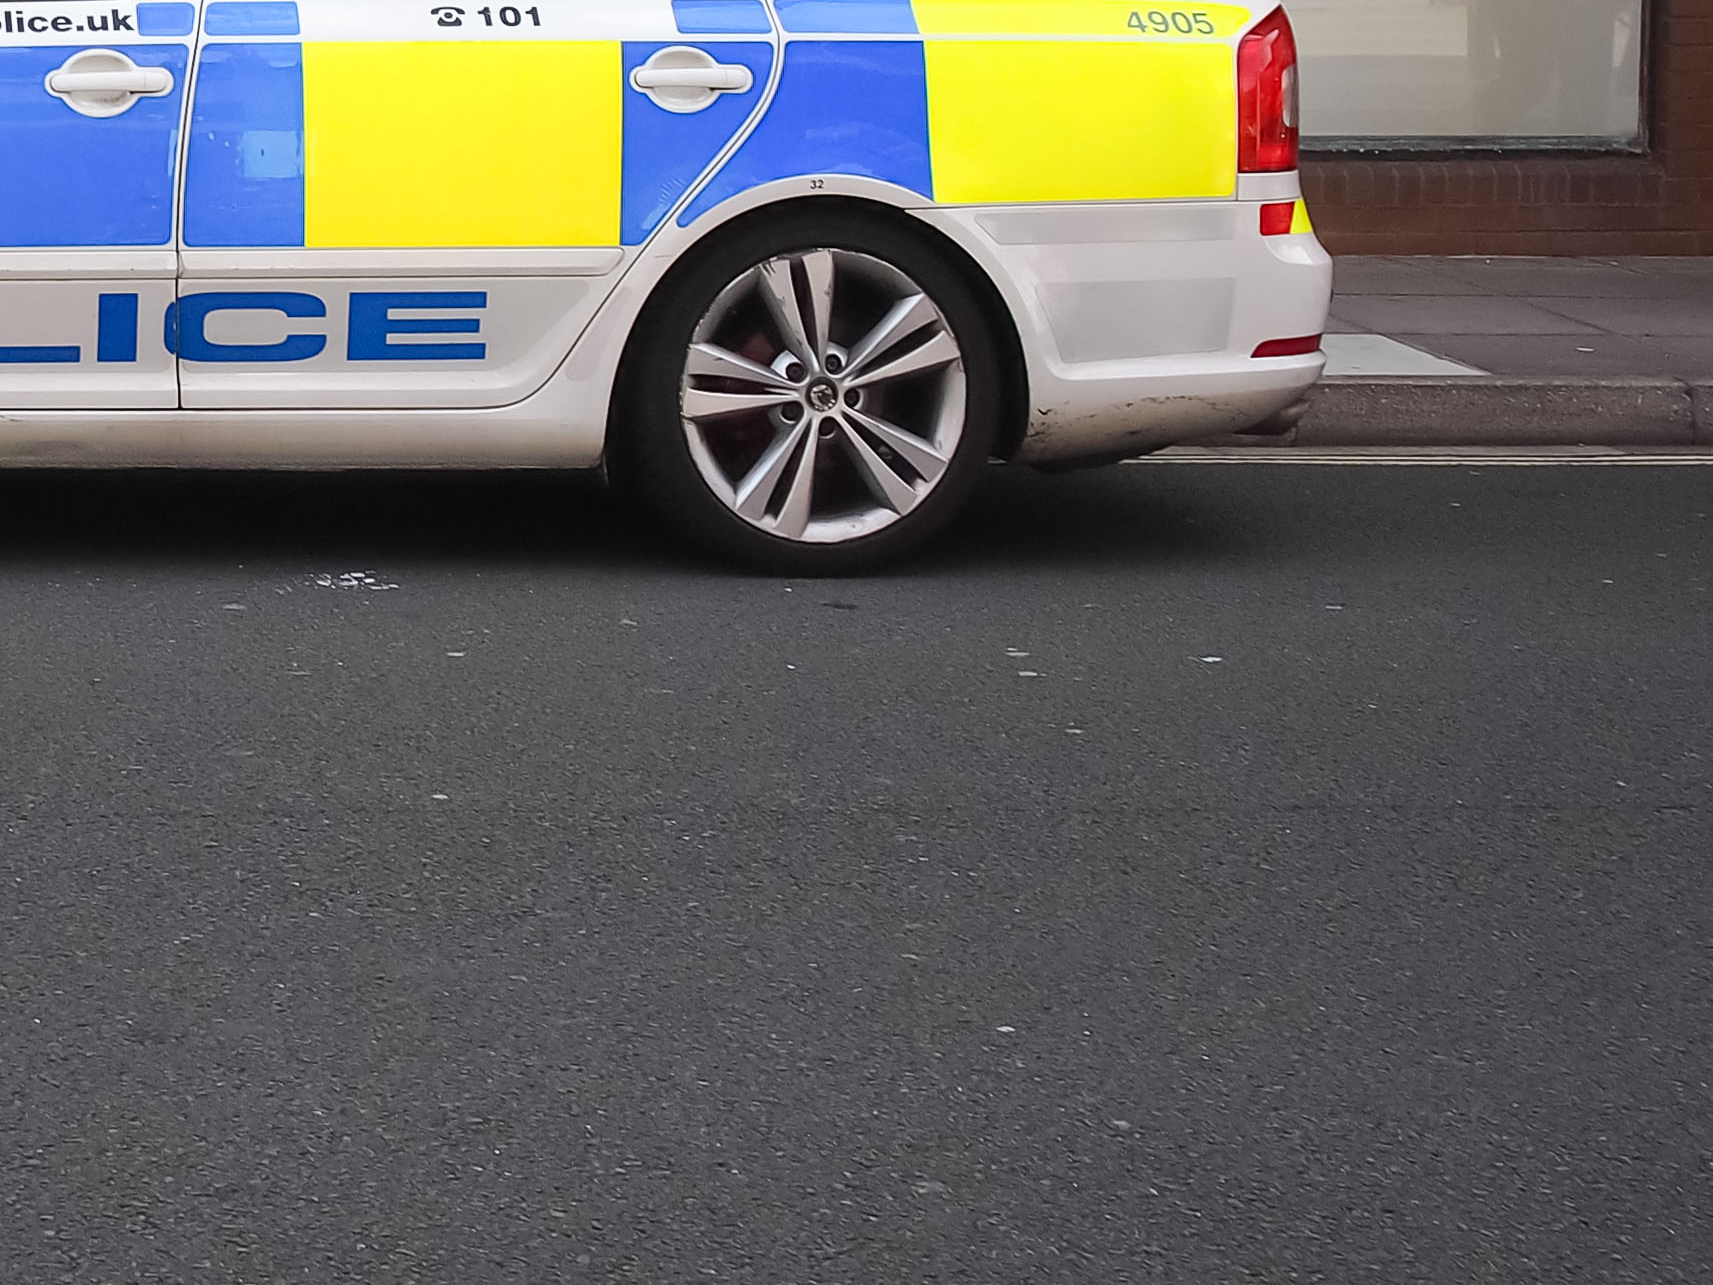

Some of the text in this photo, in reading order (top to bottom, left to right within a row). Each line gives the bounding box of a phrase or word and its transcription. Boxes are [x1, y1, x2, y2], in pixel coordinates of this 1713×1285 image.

[477, 6, 541, 27] 101
[1127, 11, 1214, 34] 4905
[809, 179, 824, 190] 32
